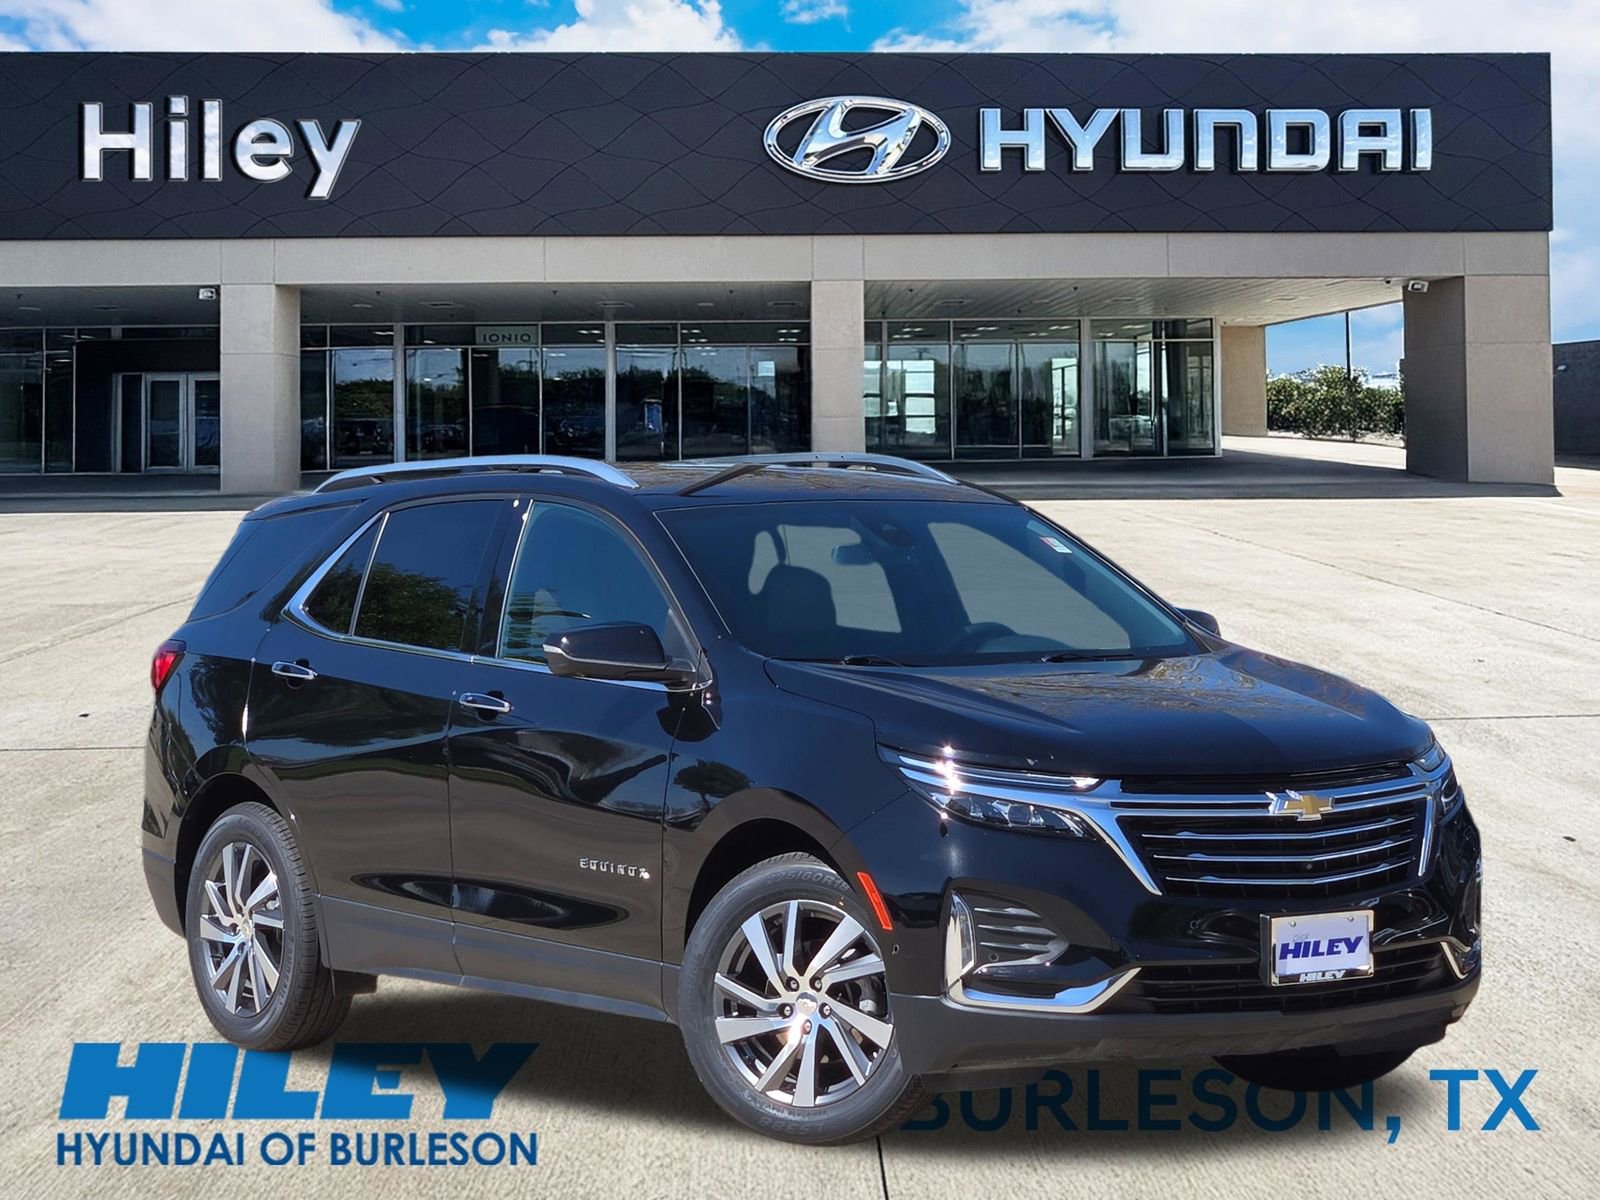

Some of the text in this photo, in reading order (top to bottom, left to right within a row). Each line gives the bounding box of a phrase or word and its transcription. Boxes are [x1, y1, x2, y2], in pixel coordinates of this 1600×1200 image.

[80, 95, 361, 200] Hiley
[979, 107, 1433, 172] HYUNDAI
[483, 332, 532, 343] IONIQ
[1279, 936, 1364, 960] HILEY
[1299, 970, 1346, 982] HILEY
